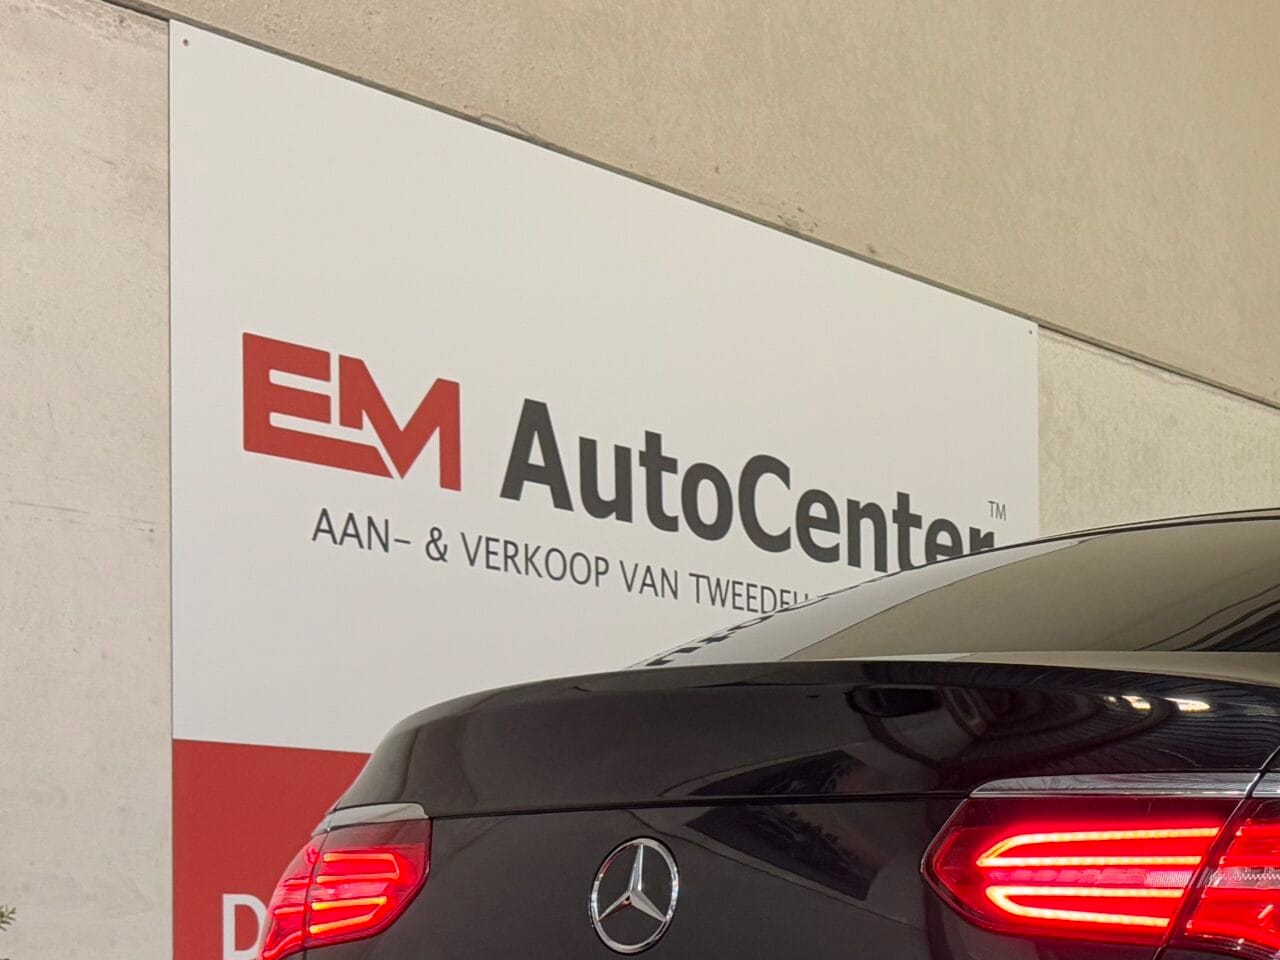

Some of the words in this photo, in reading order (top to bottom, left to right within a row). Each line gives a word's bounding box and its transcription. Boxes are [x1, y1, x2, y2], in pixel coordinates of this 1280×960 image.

[243, 332, 461, 491] EM
[425, 527, 448, 563] &
[461, 532, 610, 588] VERKOOP
[619, 560, 679, 600] VAN
